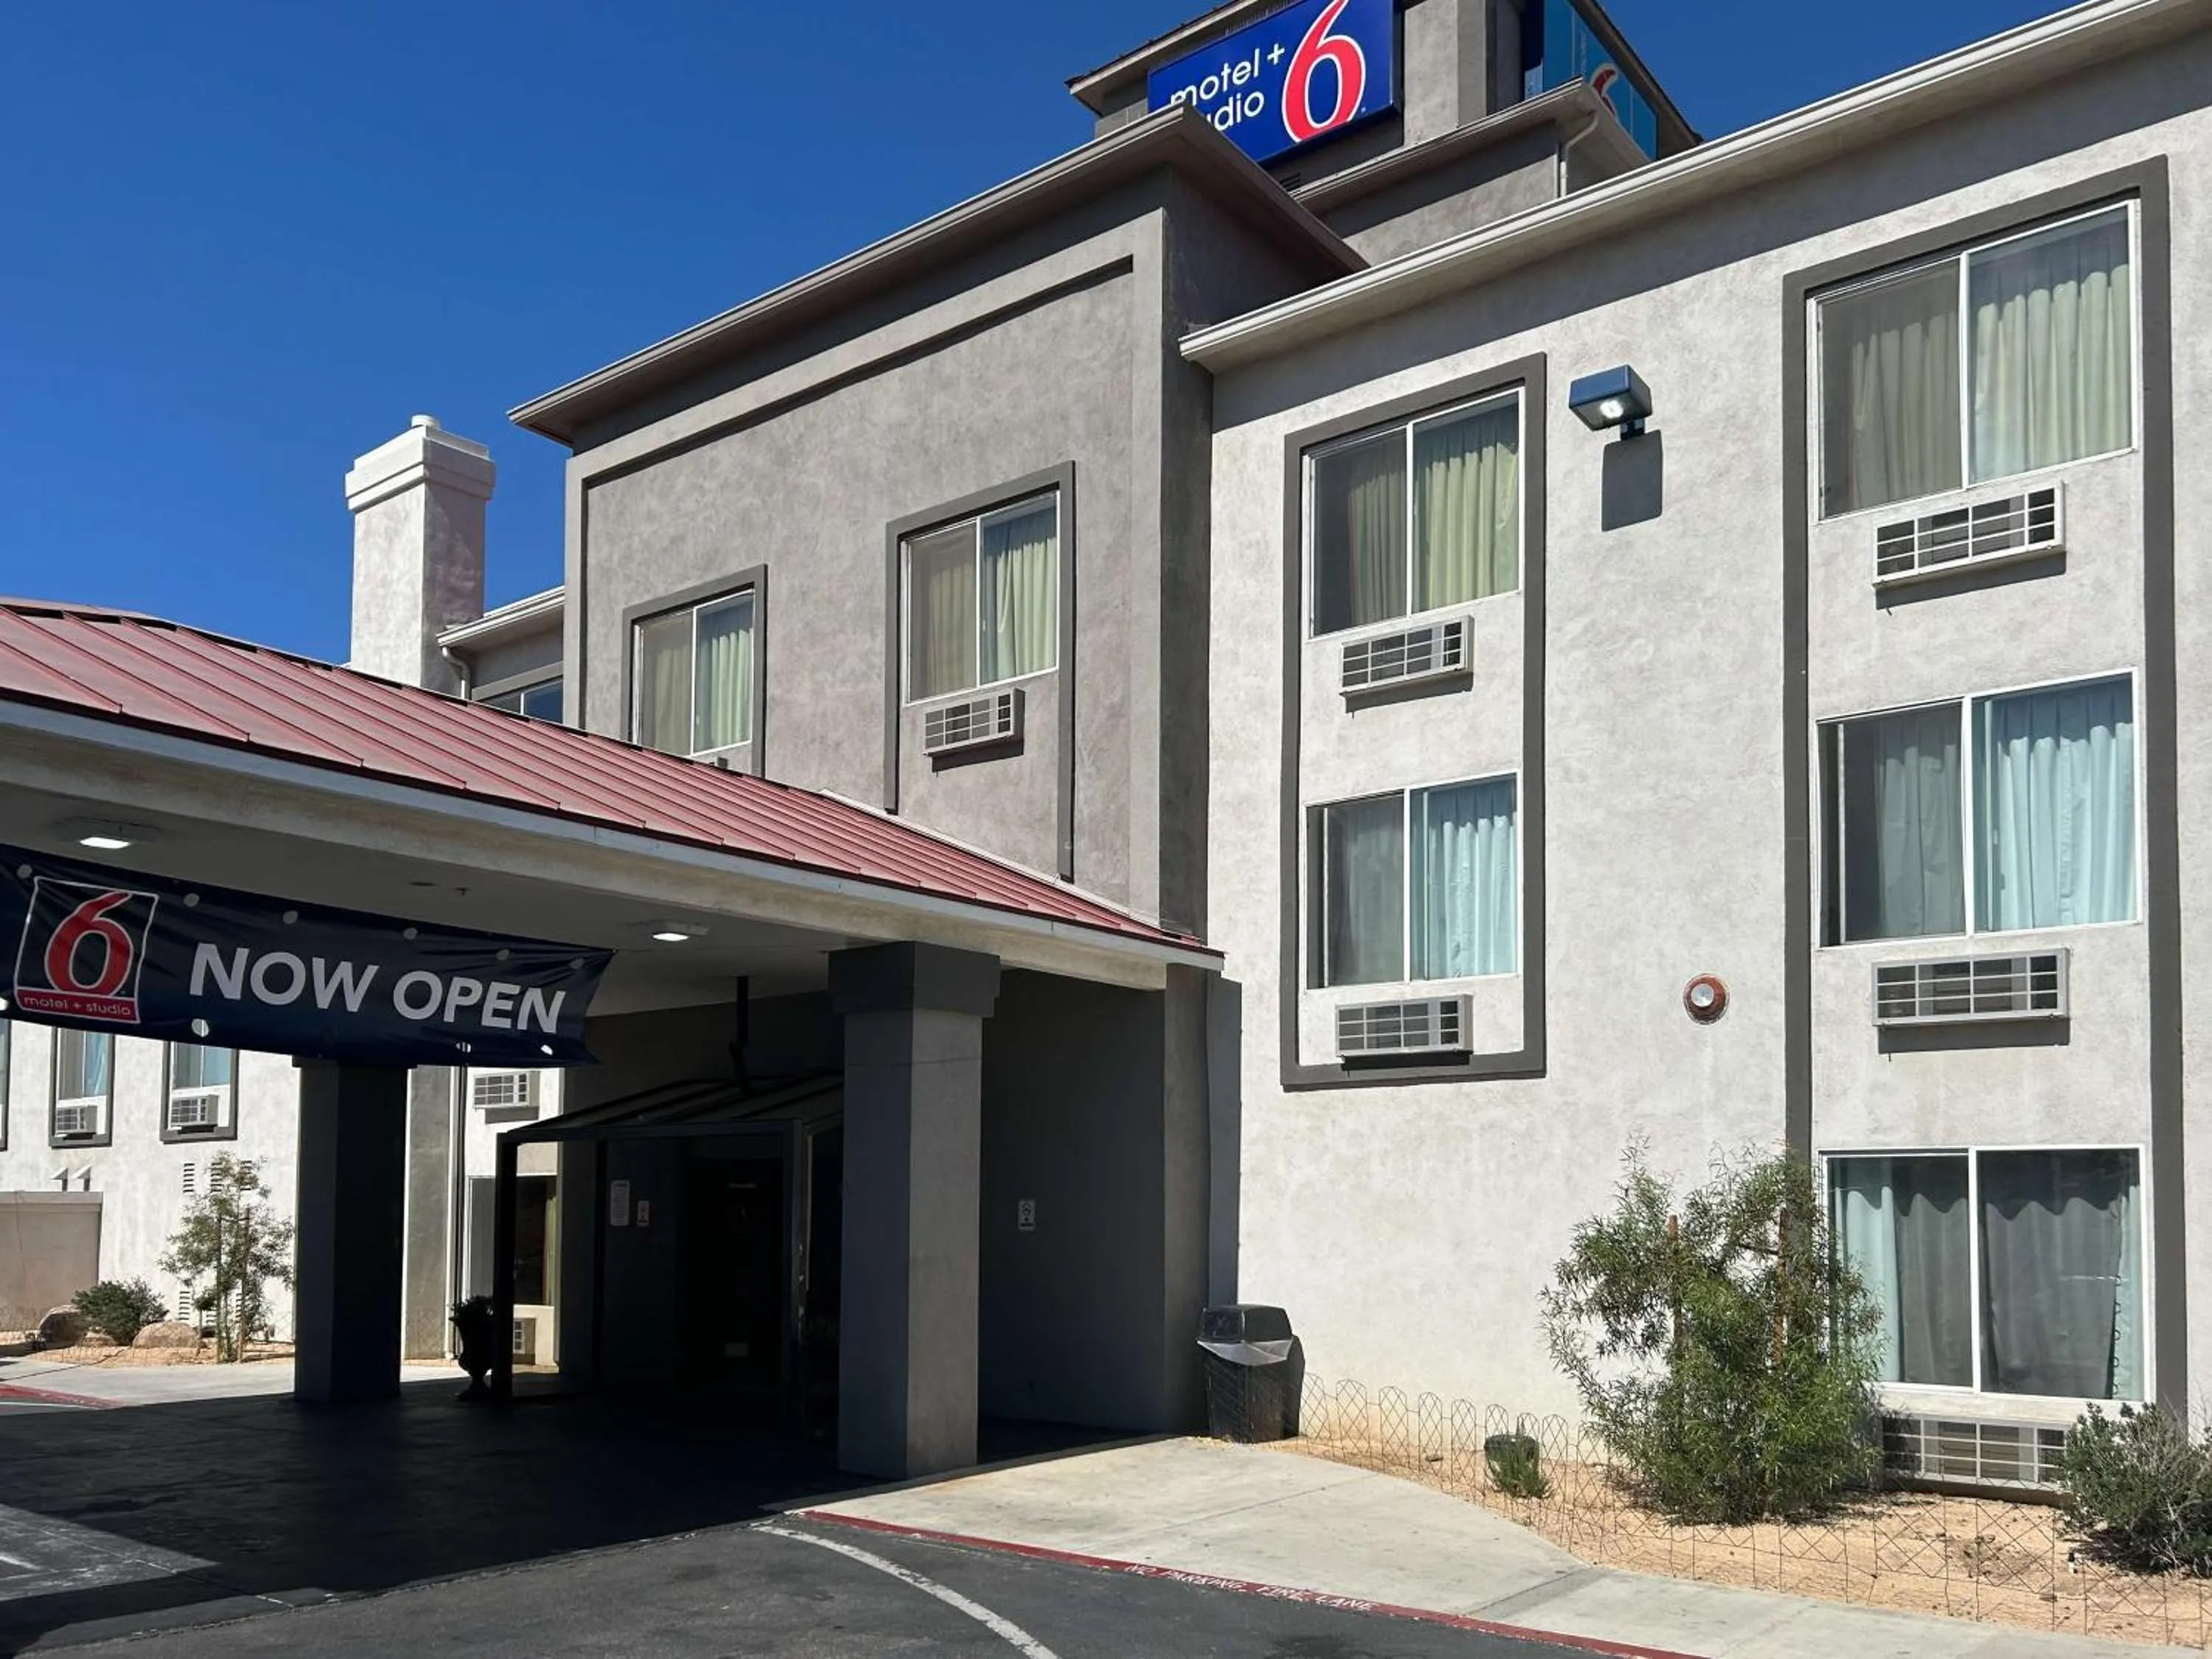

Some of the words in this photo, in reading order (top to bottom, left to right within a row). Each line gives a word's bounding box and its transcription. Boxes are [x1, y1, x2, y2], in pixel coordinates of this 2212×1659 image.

[1169, 48, 1260, 106] motel
[1281, 0, 1366, 143] 6
[1206, 91, 1265, 131] dio
[44, 890, 134, 997] 6
[24, 997, 69, 1009] motel
[86, 1002, 131, 1016] studio
[189, 942, 380, 1012] NOW
[393, 970, 567, 1034] OPEN
